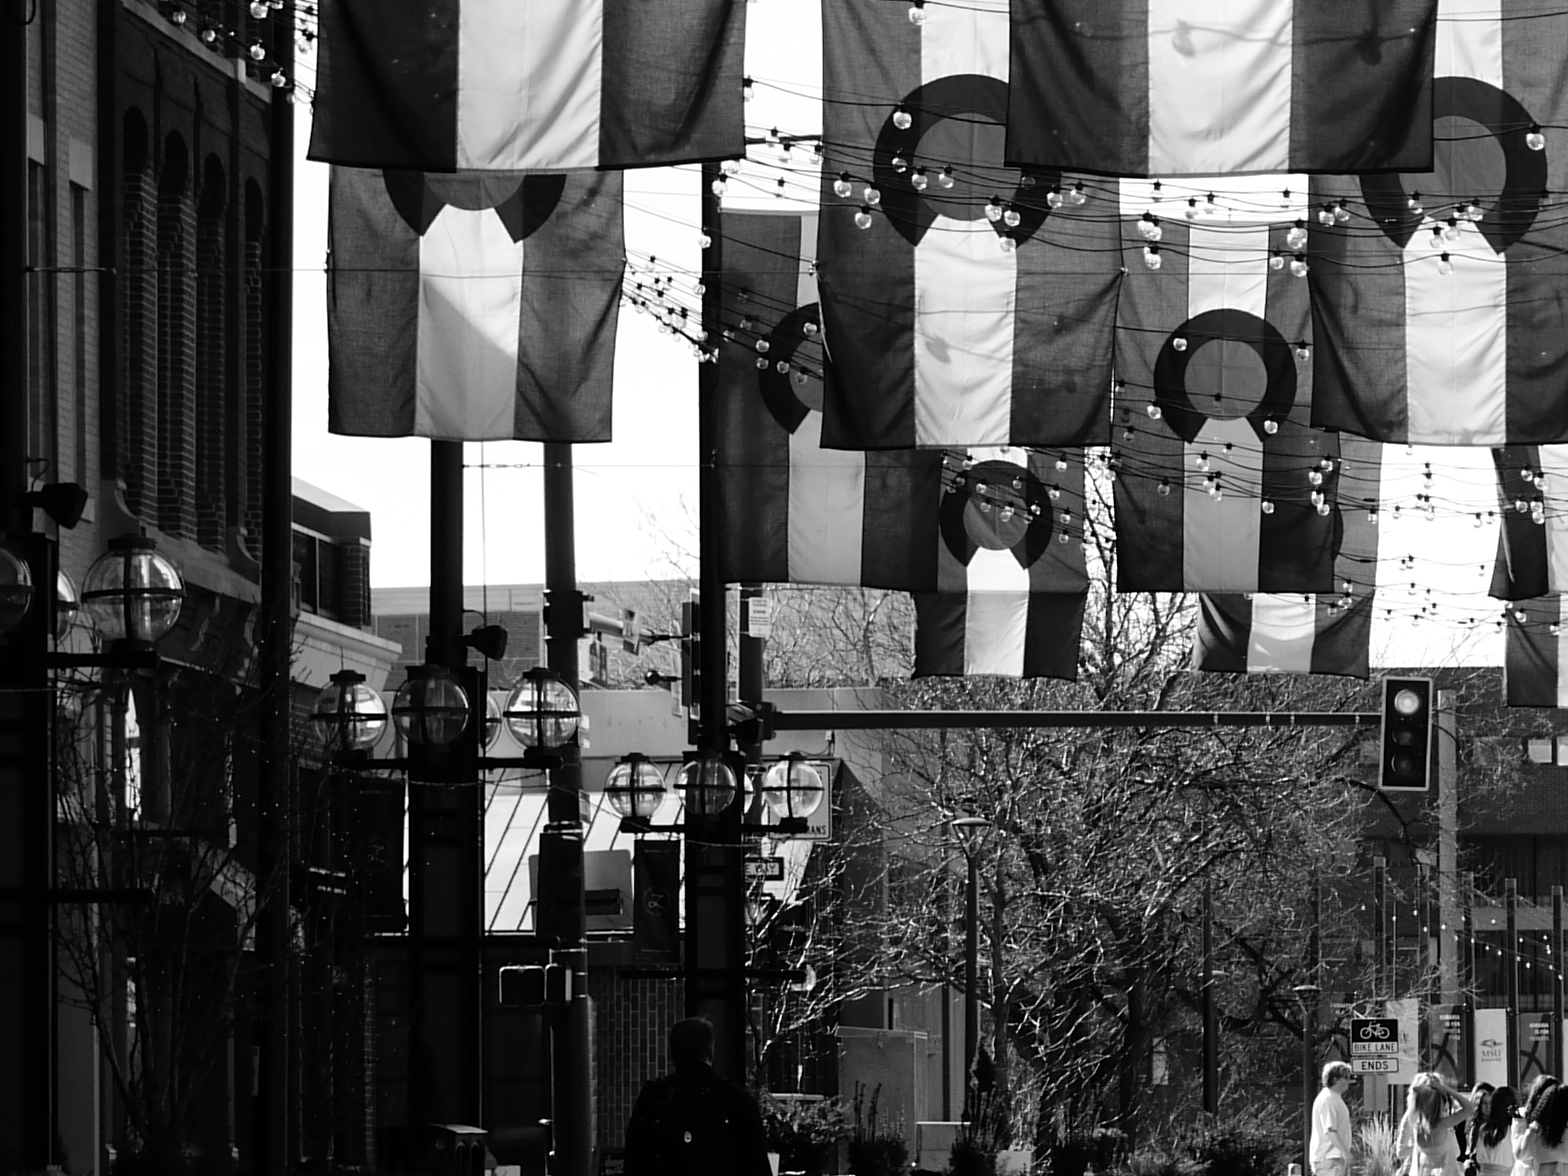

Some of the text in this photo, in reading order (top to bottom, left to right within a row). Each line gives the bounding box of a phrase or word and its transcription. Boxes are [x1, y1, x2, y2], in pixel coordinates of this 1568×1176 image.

[1354, 1043, 1396, 1052] BIKE LANE
[1361, 1061, 1389, 1071] ENDS
